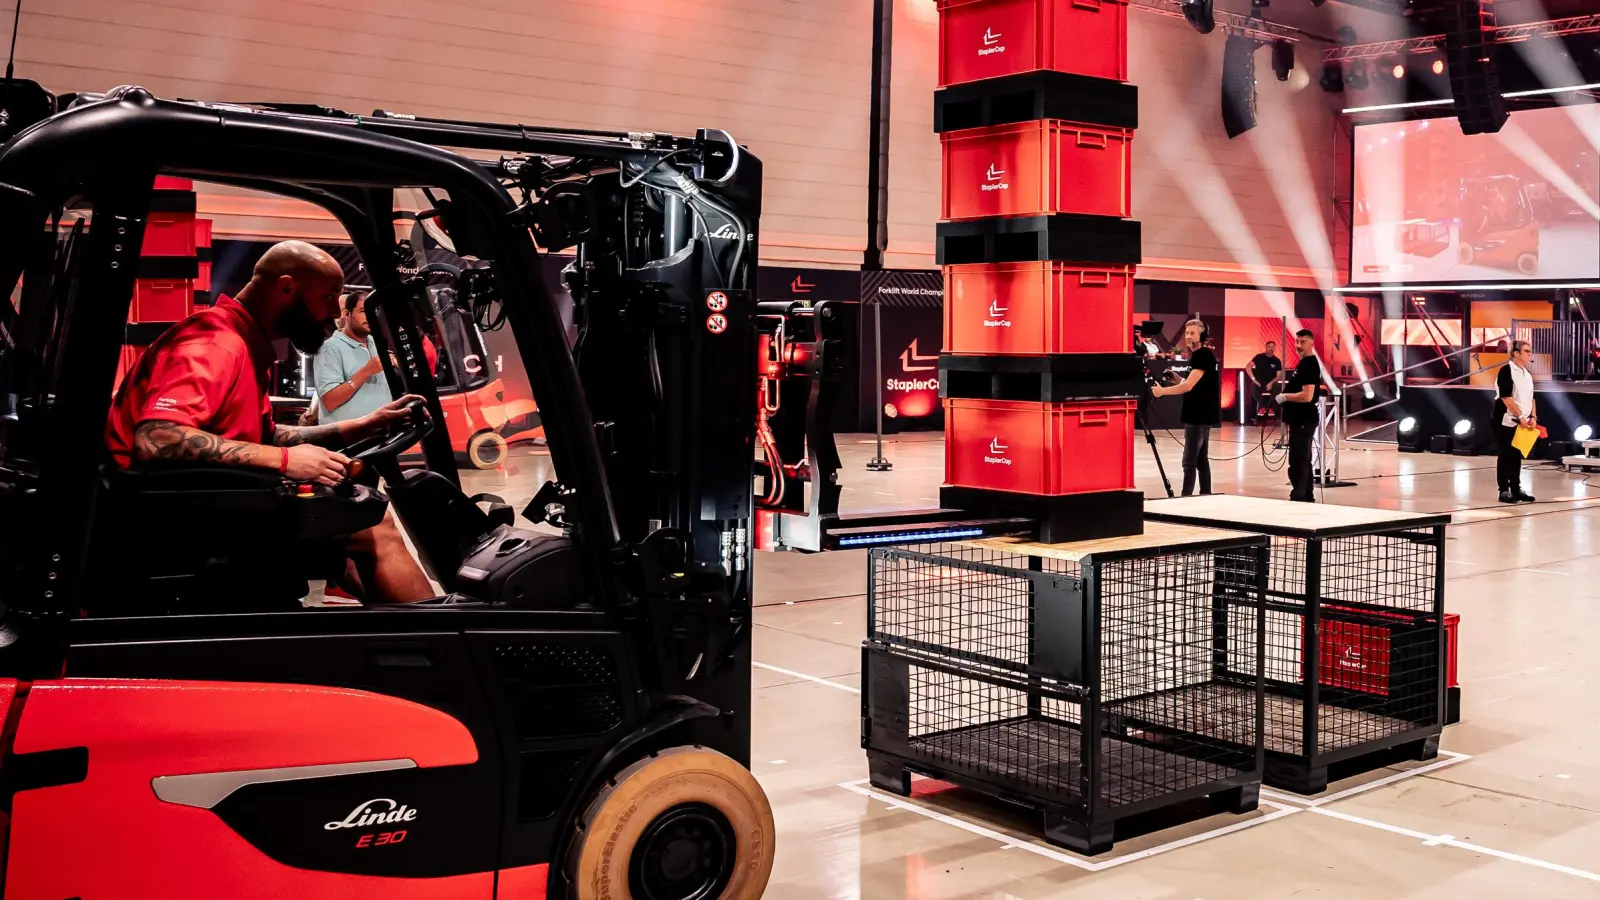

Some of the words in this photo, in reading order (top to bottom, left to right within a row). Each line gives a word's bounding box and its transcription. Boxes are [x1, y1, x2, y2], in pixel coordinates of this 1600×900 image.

[704, 223, 754, 241] Line
[878, 286, 900, 295] Forklift
[901, 287, 920, 295] World
[323, 798, 418, 830] Linde
[355, 834, 374, 848] E
[374, 830, 408, 846] 30
